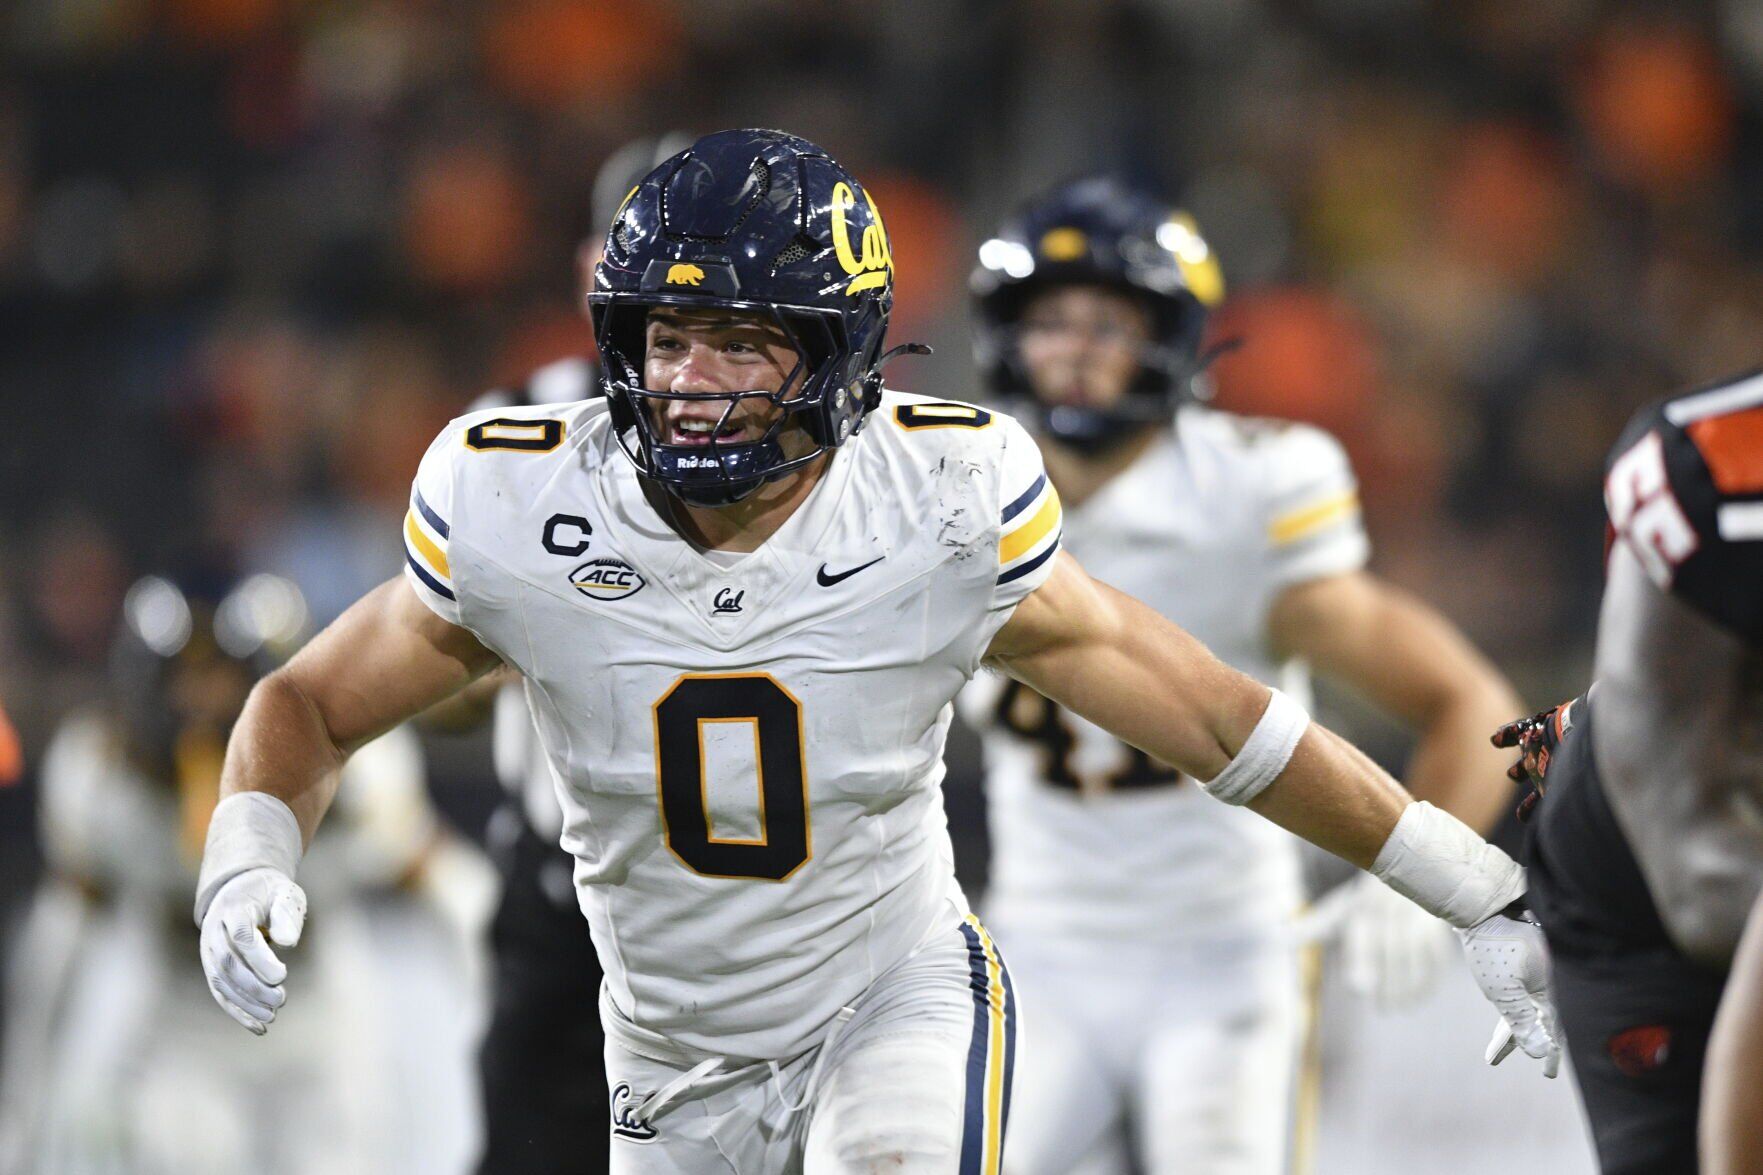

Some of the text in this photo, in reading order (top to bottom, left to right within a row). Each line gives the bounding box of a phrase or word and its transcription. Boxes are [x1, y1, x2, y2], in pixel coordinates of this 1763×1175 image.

[832, 181, 895, 296] Cal
[893, 402, 995, 432] 0
[464, 418, 566, 453] 0
[677, 457, 723, 468] Riddel
[541, 513, 593, 557] C
[581, 569, 635, 586] ACC
[712, 587, 745, 615] Cal
[651, 671, 813, 884] 0
